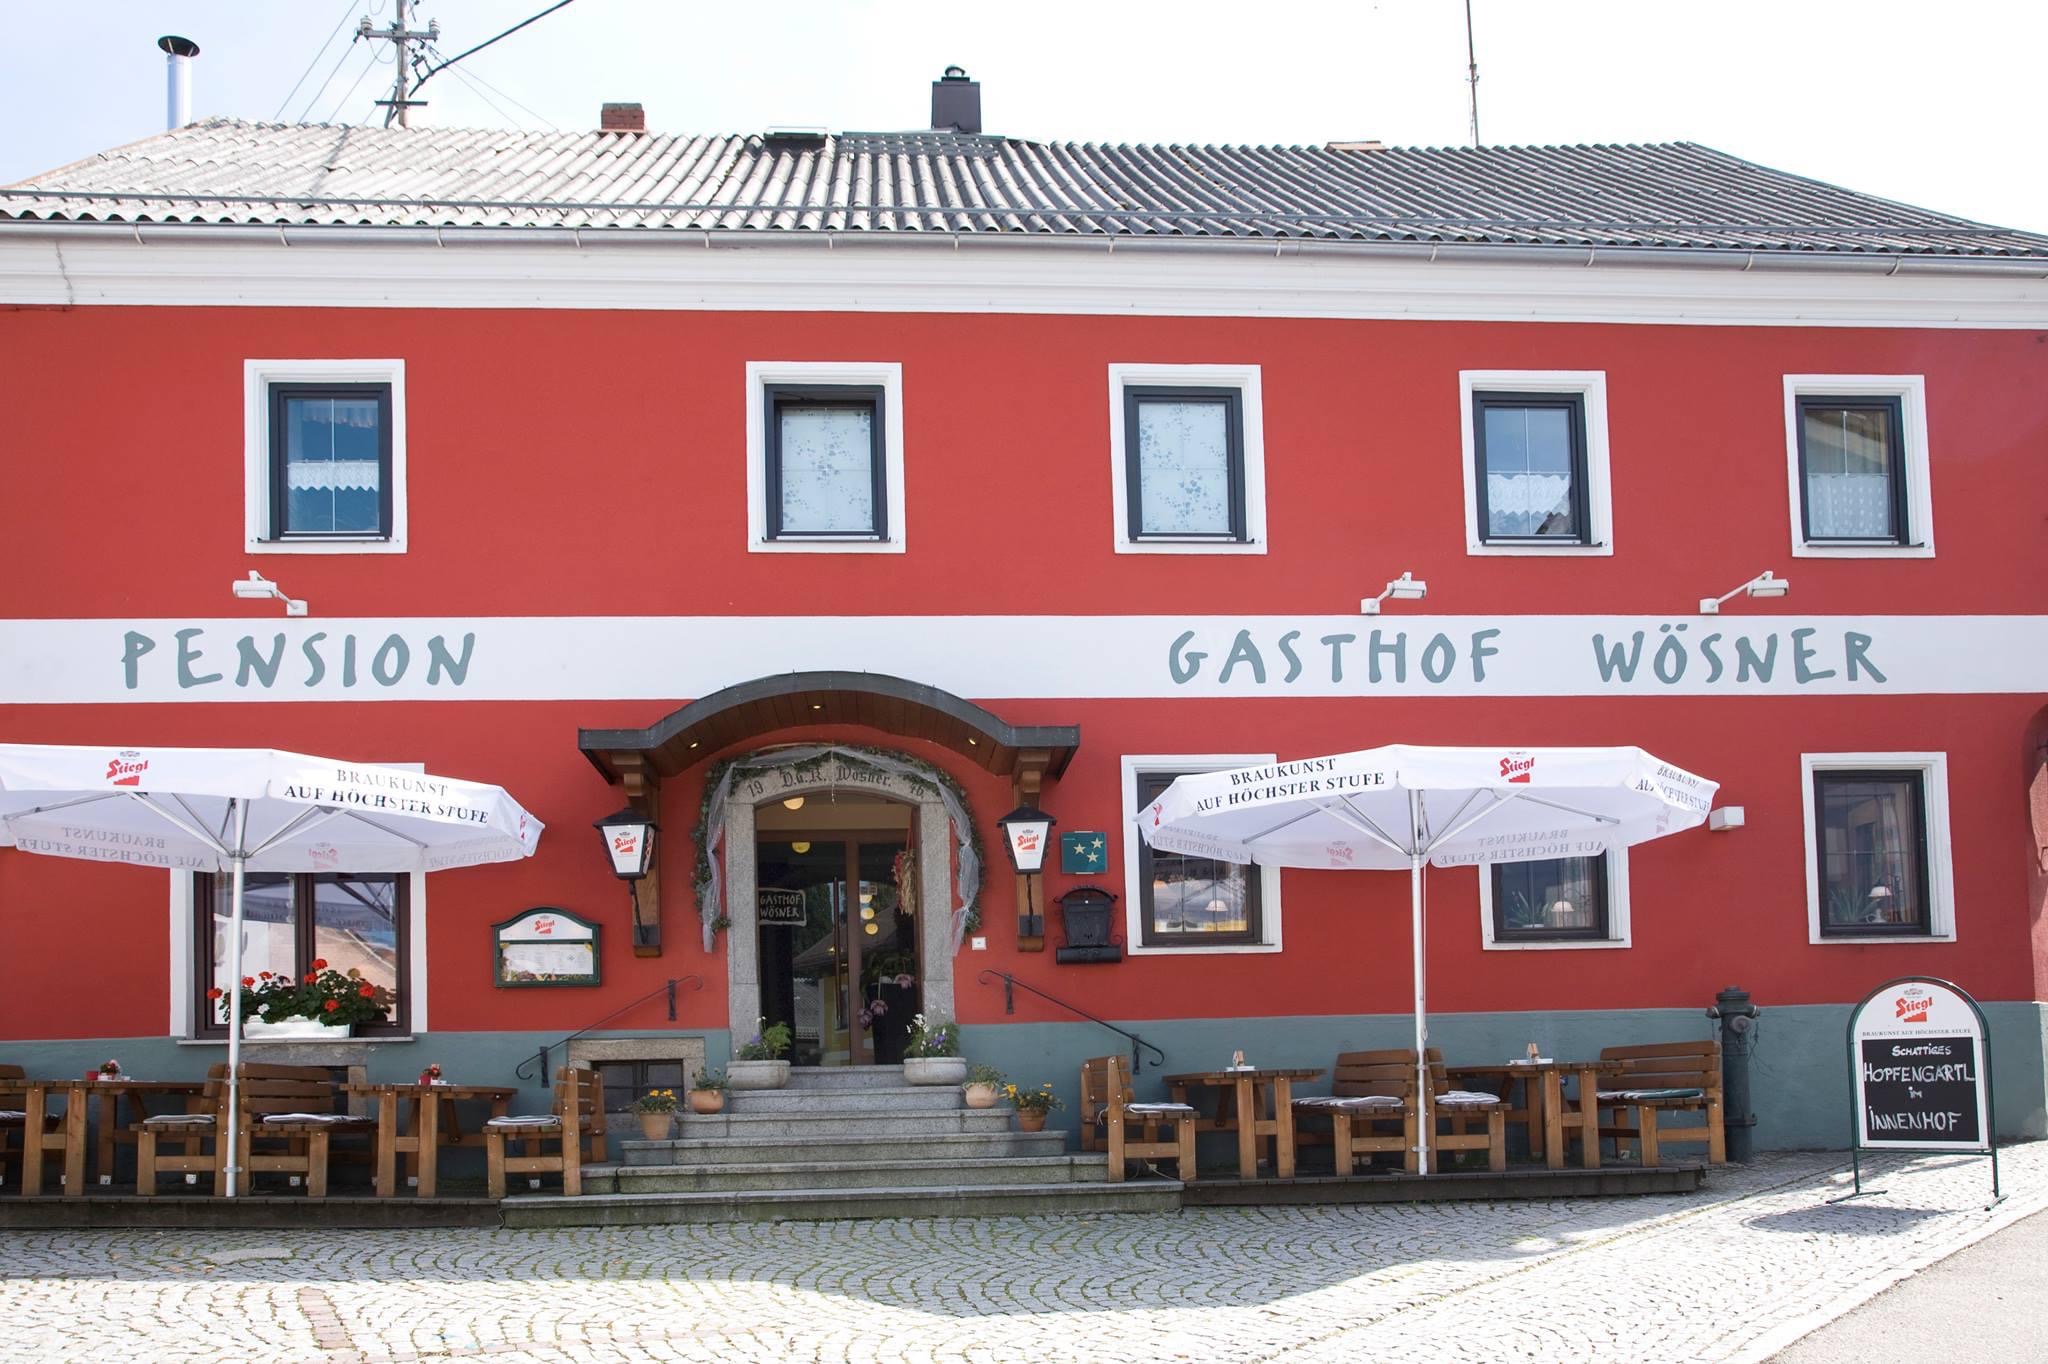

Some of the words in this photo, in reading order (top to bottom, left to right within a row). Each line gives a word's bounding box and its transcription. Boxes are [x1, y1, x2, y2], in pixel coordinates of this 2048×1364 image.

[121, 628, 475, 689] PENSION
[1169, 628, 1501, 685] GASTHOF
[1592, 623, 1887, 685] WÖSNER
[106, 759, 149, 779] Stiegl
[1230, 757, 1337, 786] BRAUKUNST
[1500, 757, 1535, 778] Stiegl
[336, 769, 448, 798] BRAUKUNST
[748, 779, 764, 798] 19
[1196, 795, 1223, 812] AUF
[1229, 780, 1320, 805] HÖCHSTER
[1326, 772, 1385, 790] STUFE
[284, 785, 324, 801] AUF
[332, 789, 433, 815] HÖCHSTER
[436, 800, 490, 824] STUFE
[760, 893, 802, 905] GASTHOF
[760, 903, 800, 918] WÖSNER
[1896, 997, 1933, 1018] Stiegl
